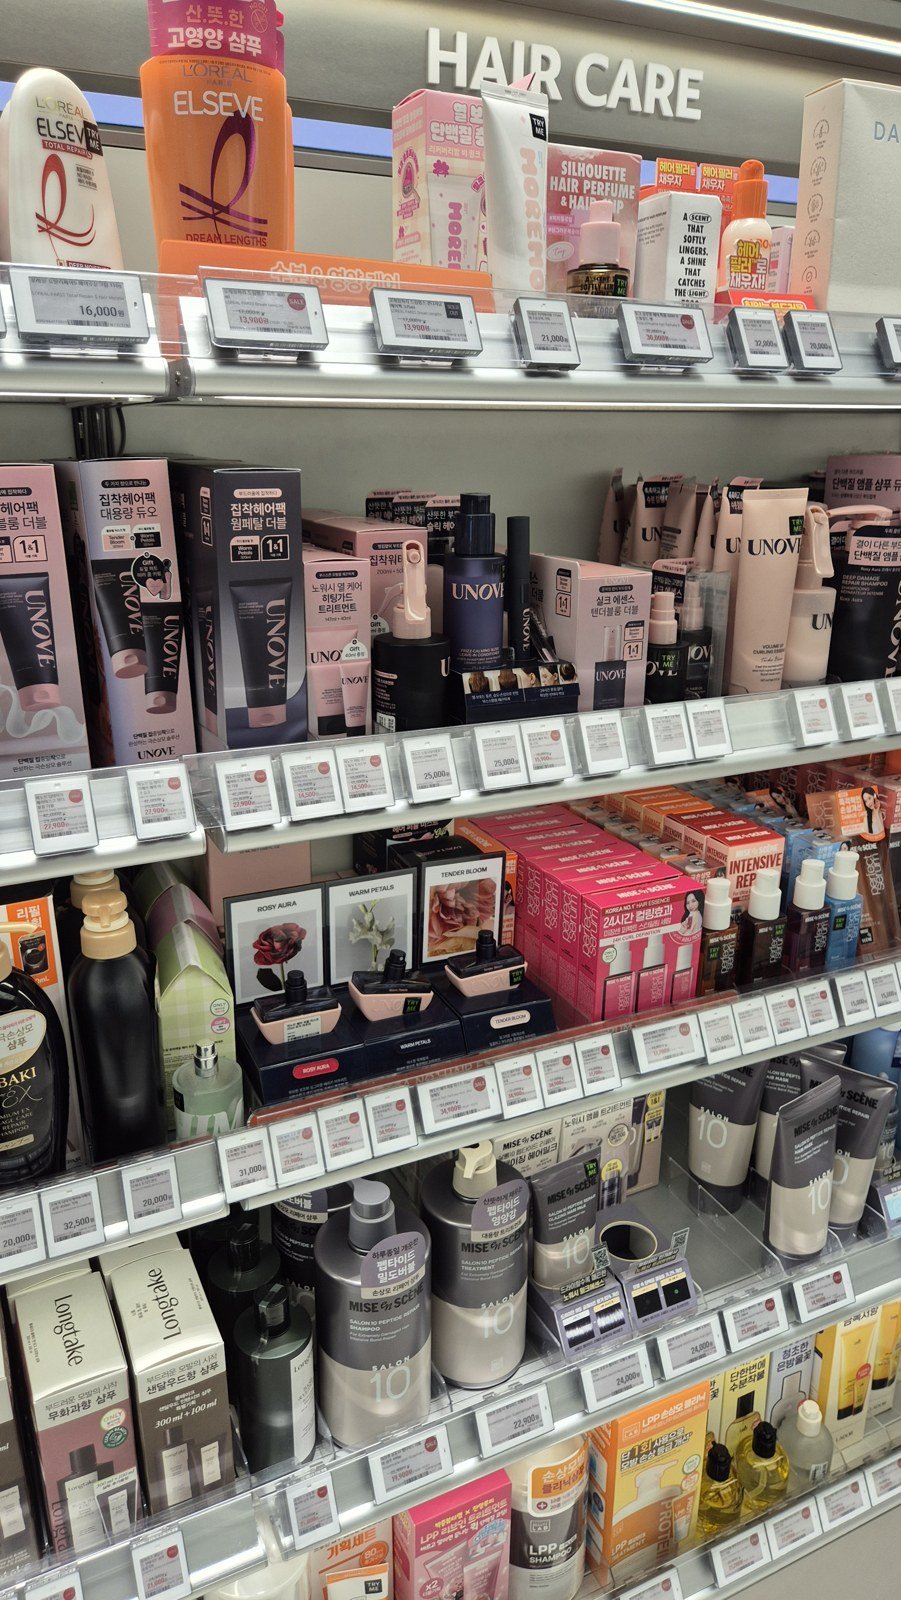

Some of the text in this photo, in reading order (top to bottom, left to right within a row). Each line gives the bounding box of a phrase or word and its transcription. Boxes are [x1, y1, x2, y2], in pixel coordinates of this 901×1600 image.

[167, 27, 262, 56] 고영양 샴푸
[427, 27, 704, 120] HAIR CARE
[173, 91, 264, 122] ELSEVE
[533, 117, 545, 127] TRY
[37, 117, 84, 144] ELSEV
[86, 127, 99, 139] TRY
[430, 121, 472, 145] 단백질
[535, 126, 545, 136] ME
[44, 140, 64, 151] TOTAL
[89, 138, 100, 150] ME
[561, 160, 626, 181] SILHOUETTE
[550, 176, 635, 199] HAIR PERFUME
[519, 146, 544, 290] MOREMO
[687, 224, 704, 233] THAT
[186, 233, 267, 247] DREAM LENGTHS
[683, 235, 706, 245] SOFTLY
[679, 246, 708, 256] LINGERS.
[687, 257, 706, 267] SHINE
[684, 267, 701, 277] THAT
[677, 277, 705, 288] CATCHES
[674, 288, 686, 298] THE
[832, 477, 892, 492] 단백질 앰플 샴푸
[99, 492, 156, 506] 집착헤어팩
[1, 501, 39, 515] 헤어팩
[101, 506, 158, 520] 대용량 듀오
[230, 502, 286, 516] 집착헤어팩
[22, 516, 47, 529] 더블
[266, 516, 287, 529] 더블
[791, 518, 803, 526] TRY
[856, 539, 889, 550] 결이 다른
[854, 550, 901, 562] 단백질 앰플
[312, 581, 363, 593] 노워시 케어
[119, 571, 144, 635] UNOVE
[321, 593, 353, 602] 히팅가드
[596, 594, 635, 606] 실크 에센스
[318, 603, 357, 614] 트리트먼트
[25, 589, 56, 669] UNOVE
[163, 615, 180, 679] UNOVE
[266, 598, 287, 689] UNOVE
[662, 654, 675, 662] TRY
[342, 675, 369, 686] UNOVE
[595, 668, 625, 682] UNOVE
[137, 746, 176, 760] UNOVE
[729, 852, 782, 875] INTENSIVE
[441, 867, 488, 878] TENDER BLOOM
[349, 884, 395, 897] WARM PETALS
[16, 904, 40, 919] 리필
[257, 900, 297, 913] ROSY AURA
[605, 896, 671, 915] KOREA ESSENCE
[603, 905, 673, 928] 24시간 컬링효과
[622, 928, 662, 942] CURL DEFINITION
[512, 1013, 526, 1021] BLOOM
[7, 1038, 27, 1051] 샴푸
[400, 1038, 431, 1050] WARM PETALS
[317, 1063, 330, 1071] AURA
[776, 1075, 789, 1083] MASK
[846, 1091, 879, 1109] SCÈNE
[564, 1099, 632, 1128] 노워시 트리트먼트
[700, 1106, 730, 1123] SALON
[853, 1110, 870, 1120] REPAIR
[794, 1105, 838, 1137] MISE SCÈNE
[698, 1114, 728, 1149] 10
[503, 1127, 553, 1151] MISE SCÈNE
[809, 1169, 833, 1186] SALON
[547, 1176, 598, 1206] MISE SCÈNE
[808, 1178, 831, 1216] 10
[487, 1196, 521, 1217] 펩타이드
[491, 1209, 517, 1227] 영양감
[563, 1227, 589, 1242] SALON
[372, 1247, 399, 1260] 하루종일
[461, 1242, 489, 1254] MISE
[562, 1236, 590, 1269] 10
[376, 1250, 416, 1272] 펩타이드
[377, 1261, 416, 1283] 밀도버블
[349, 1282, 424, 1313] MISE SCÈNE
[372, 1287, 391, 1297] 손상모
[147, 1267, 182, 1340] Longtake
[481, 1292, 515, 1310] SALON
[378, 1315, 402, 1325] PEPTIDE
[481, 1303, 514, 1338] 10
[53, 1294, 85, 1367] Longtake
[371, 1356, 411, 1371] SALON
[145, 1361, 220, 1395] 샌달우드향 샴푸
[369, 1365, 411, 1403] 10
[48, 1389, 117, 1421] 무화과향 샴푸
[154, 1416, 171, 1429] 300
[642, 1404, 684, 1428] LPP 손상모
[420, 1533, 439, 1545] LPP
[468, 1498, 508, 1524] 트리트먼트
[532, 1525, 549, 1533] LAB
[529, 1543, 558, 1556] LPP
[529, 1546, 572, 1564] SHAMPOO
[367, 1581, 380, 1589] TRY
